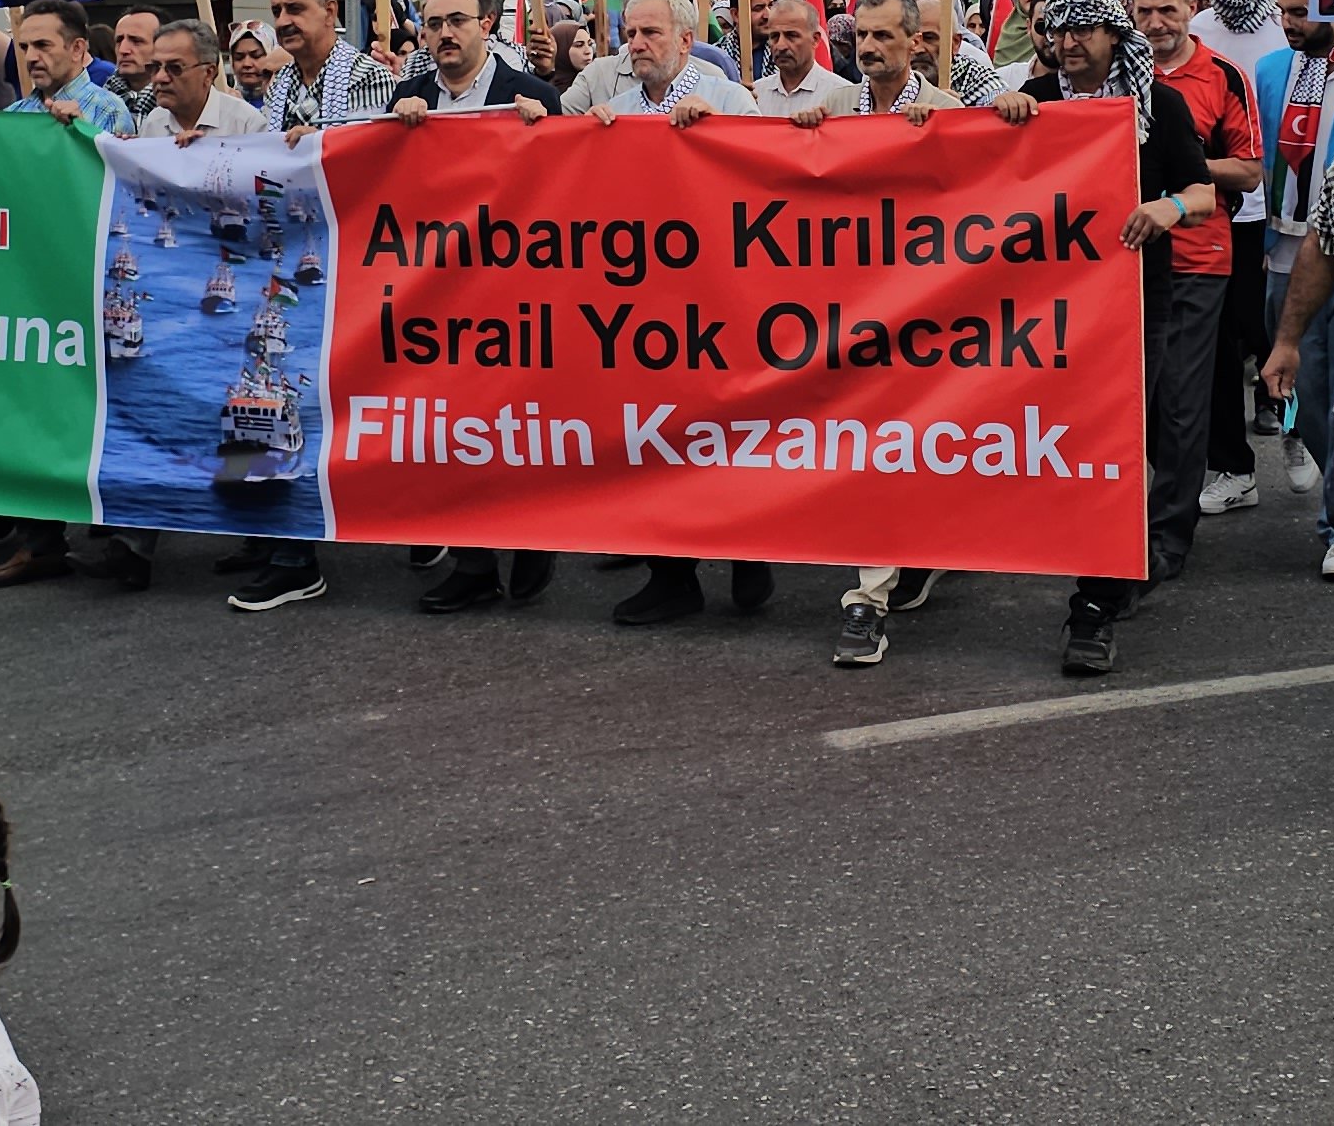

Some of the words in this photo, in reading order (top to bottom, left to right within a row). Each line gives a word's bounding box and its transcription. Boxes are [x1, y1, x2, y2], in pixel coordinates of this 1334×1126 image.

[362, 202, 700, 287] Ambargo
[732, 191, 1102, 269] Kırılacak
[379, 283, 555, 370] İsrail
[578, 300, 729, 371] Yok
[755, 297, 1069, 370] Olacak!
[344, 393, 595, 467] Filistin
[623, 402, 1121, 480] Kazanacak..
